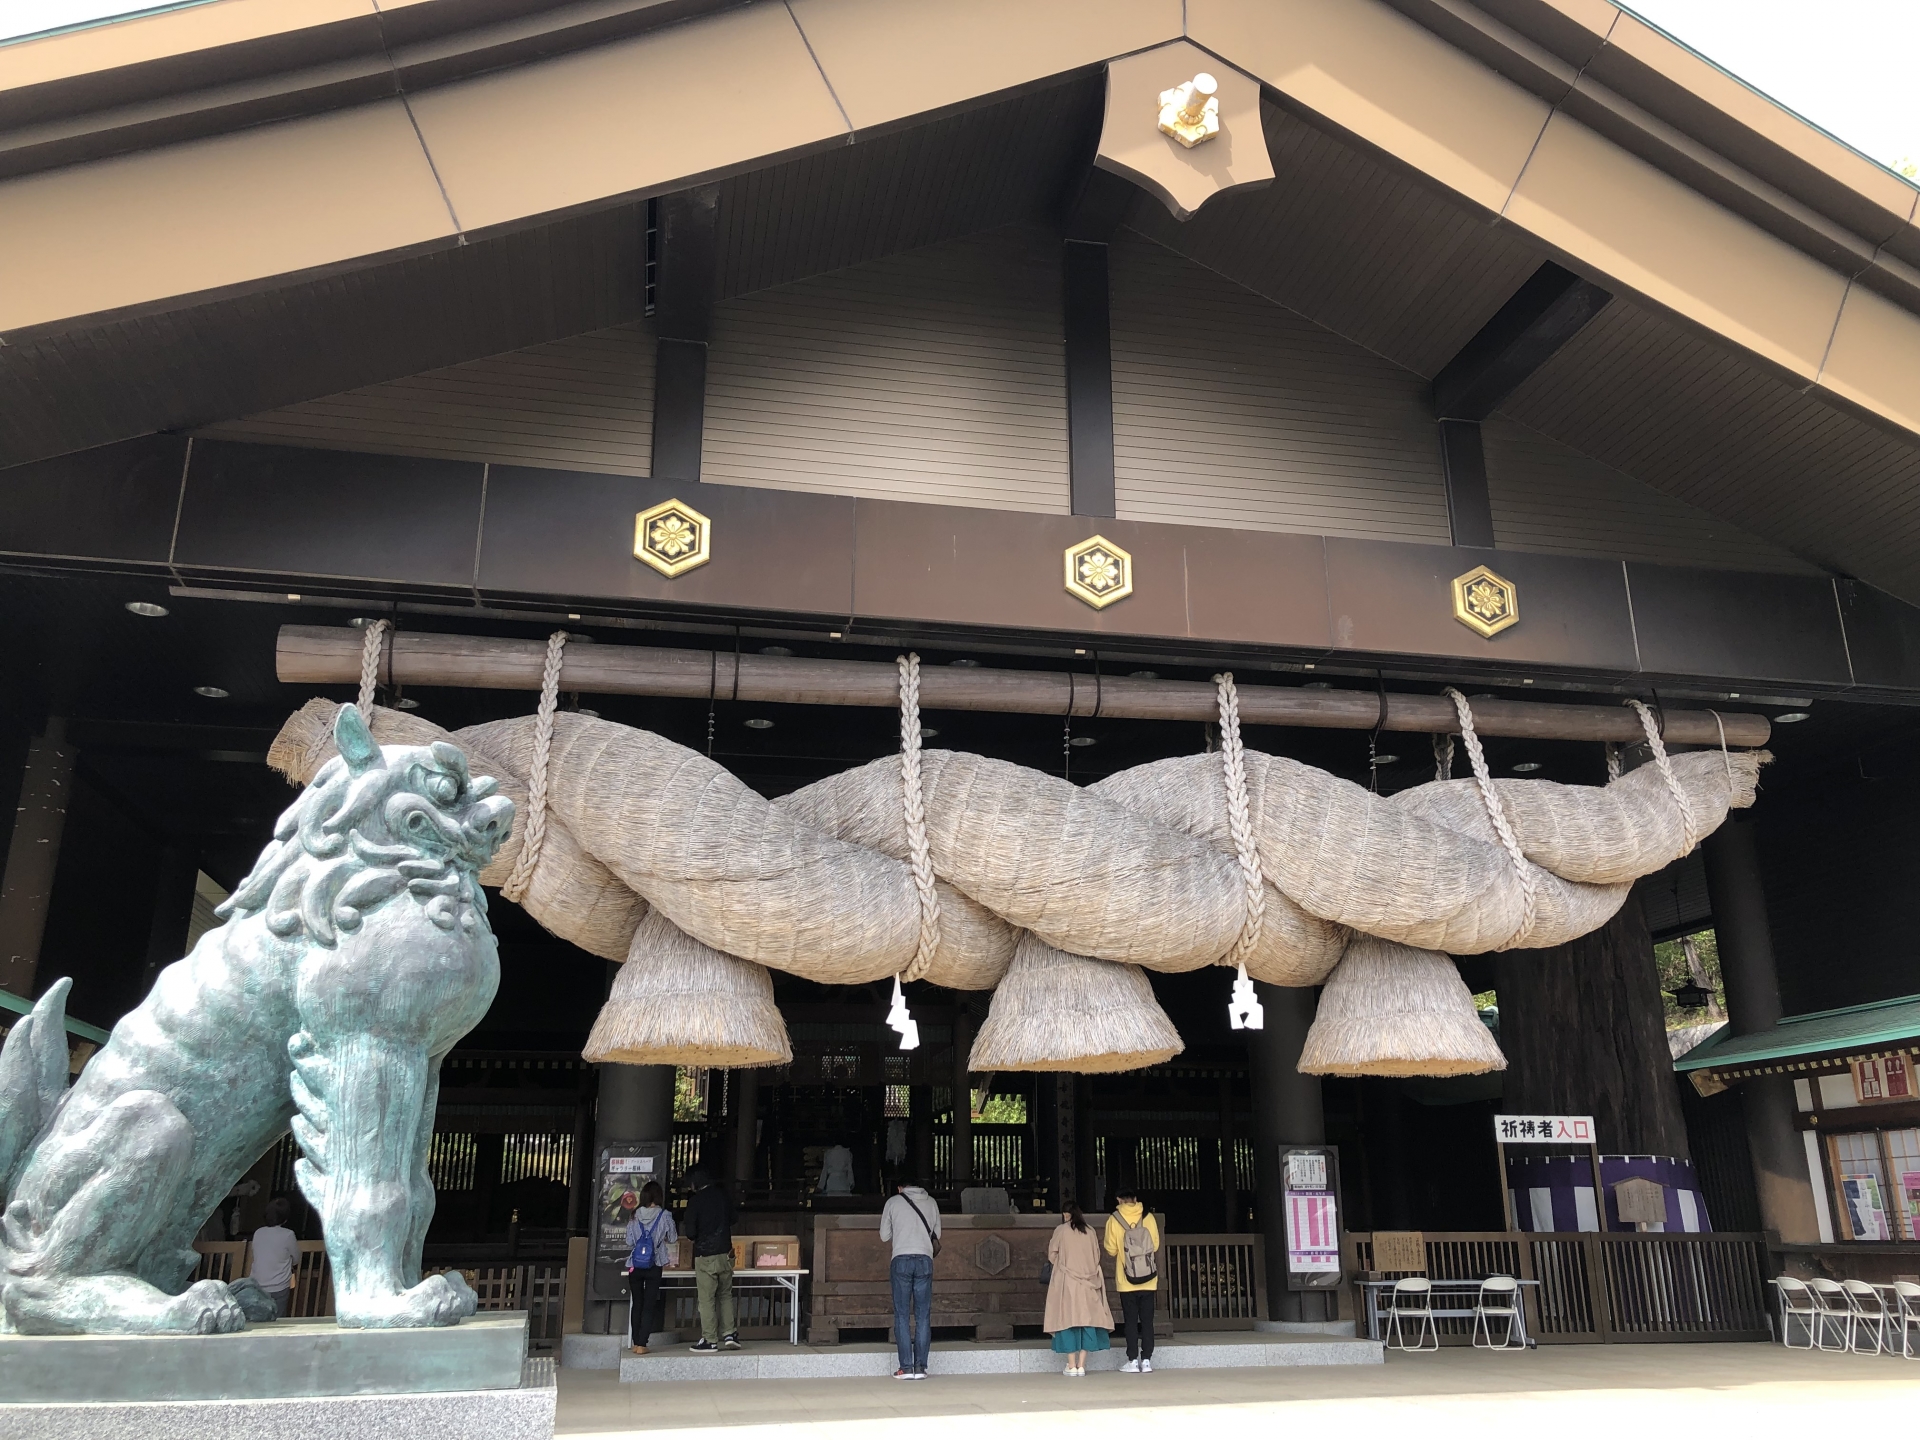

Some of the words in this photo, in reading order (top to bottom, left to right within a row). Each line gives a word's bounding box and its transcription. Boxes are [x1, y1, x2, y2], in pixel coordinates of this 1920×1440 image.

[1501, 1119, 1589, 1139] 祈祷者入口
